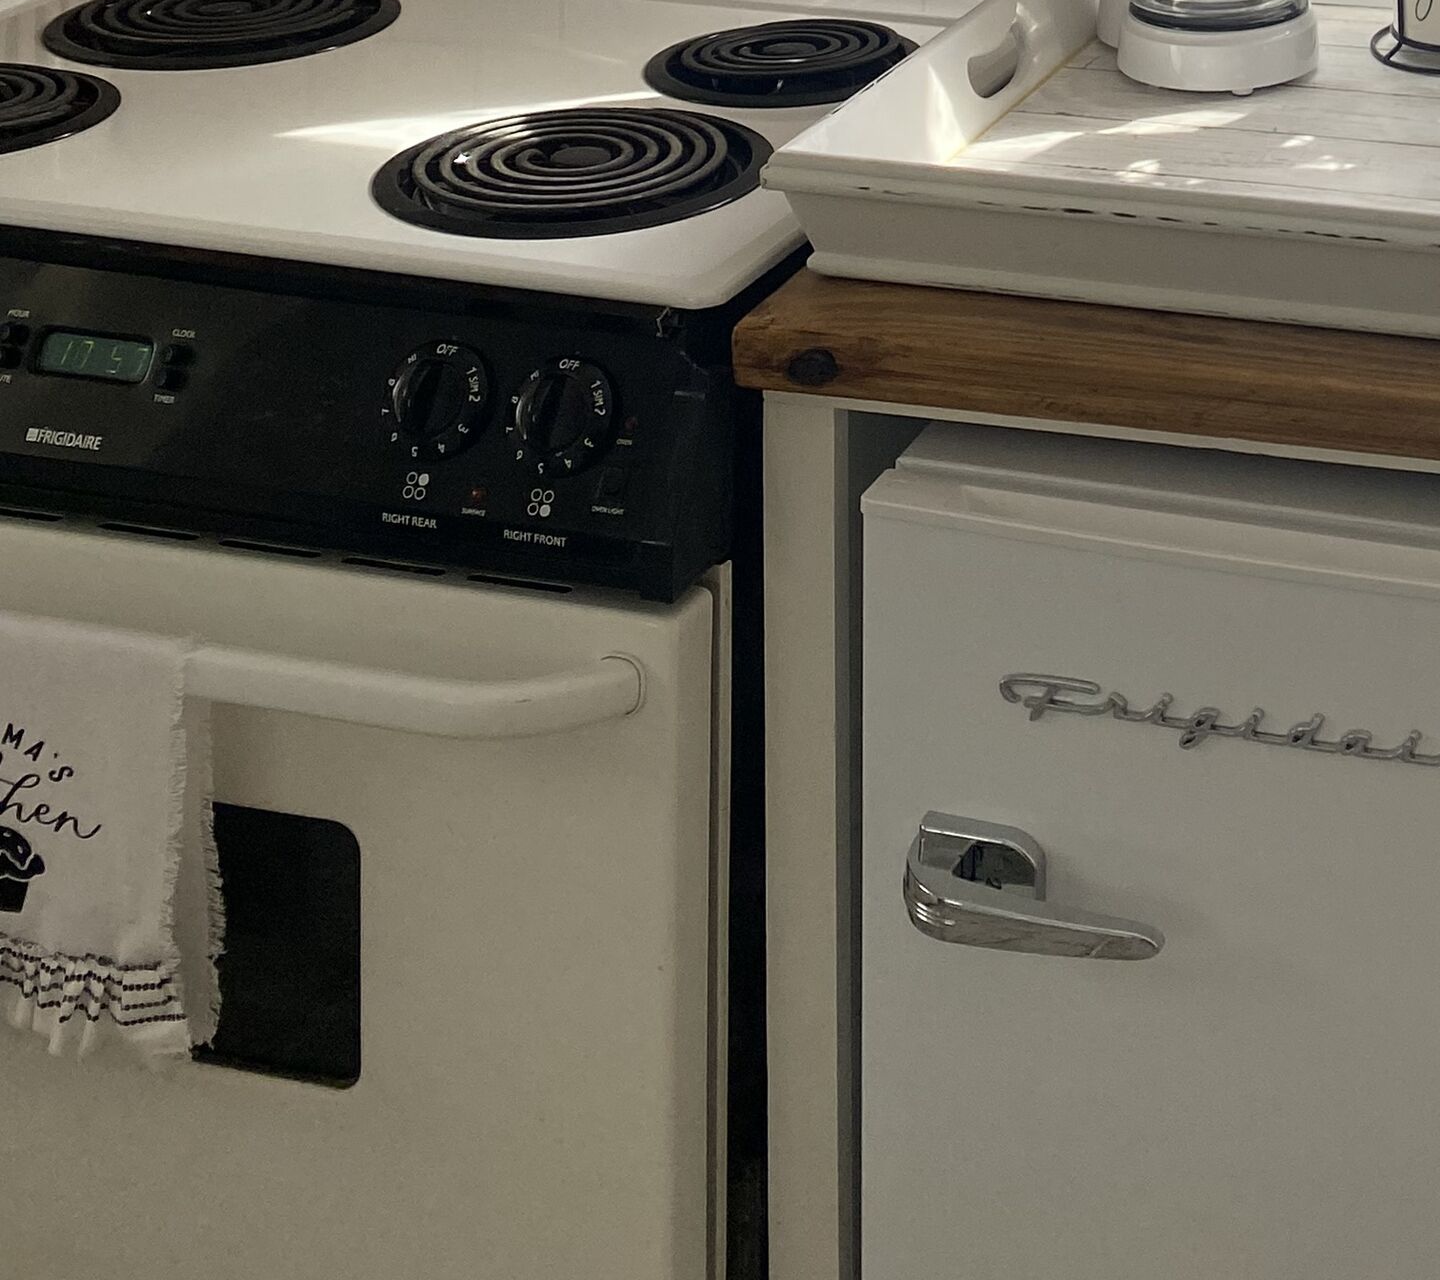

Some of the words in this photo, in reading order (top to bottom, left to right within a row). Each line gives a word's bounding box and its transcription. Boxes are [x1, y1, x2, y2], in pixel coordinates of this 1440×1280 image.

[558, 358, 581, 371] OFF
[36, 427, 103, 451] FRIGIDAIRE
[382, 512, 410, 527] RIGHT
[411, 516, 438, 529] REAR
[503, 529, 533, 544] RIGHT
[533, 532, 568, 548] FRONT
